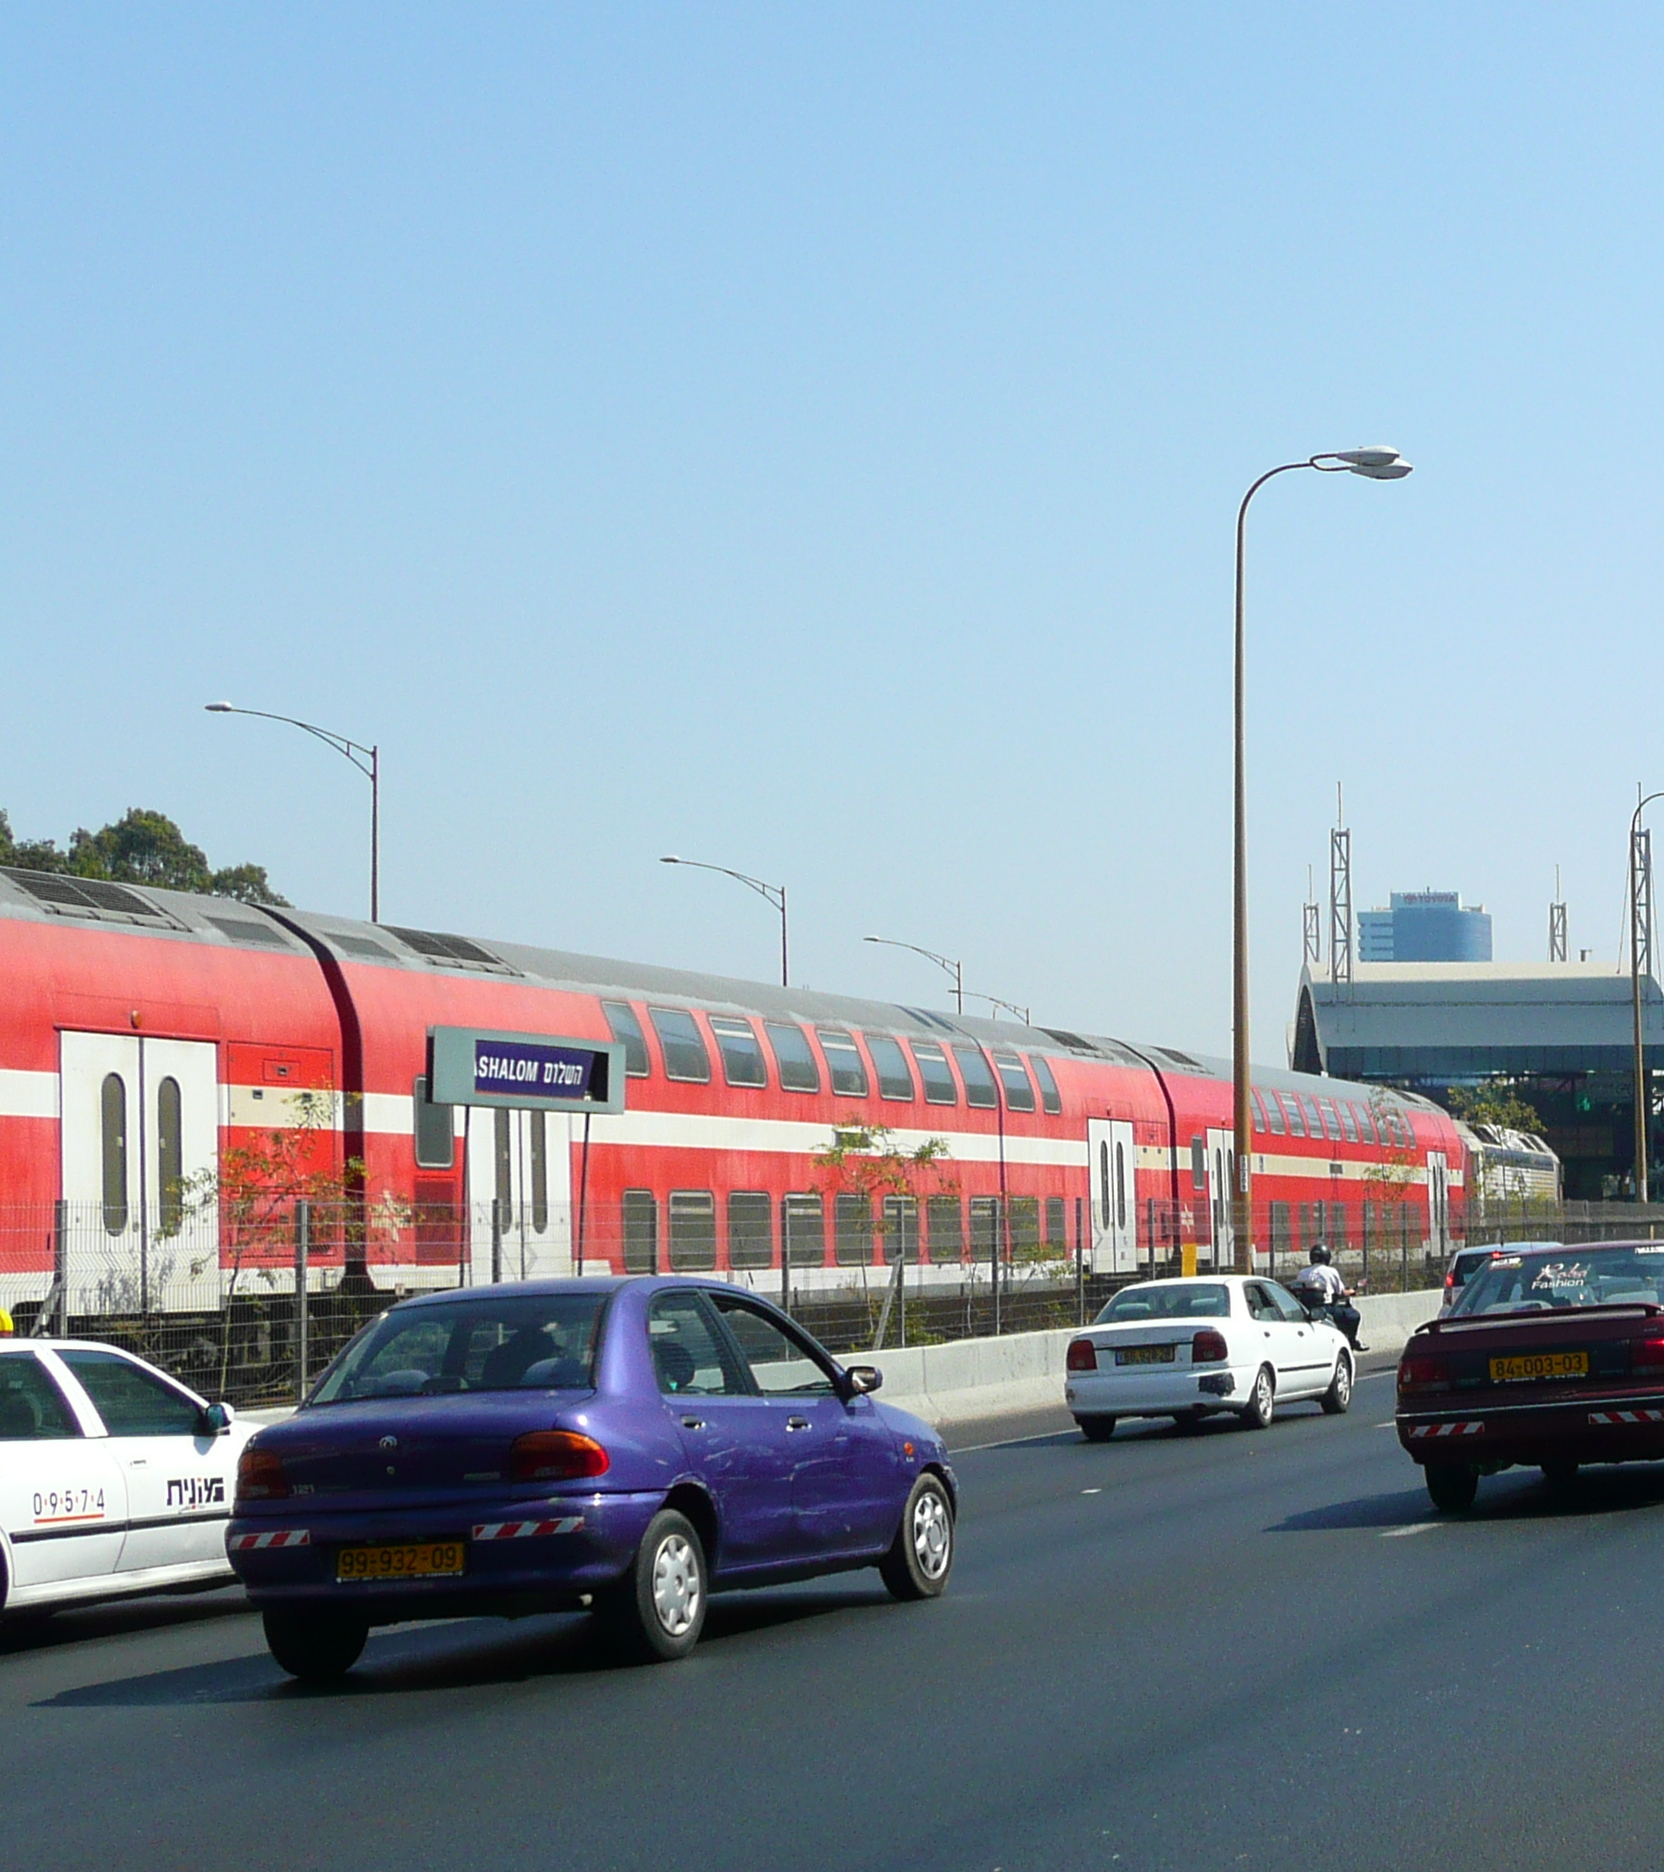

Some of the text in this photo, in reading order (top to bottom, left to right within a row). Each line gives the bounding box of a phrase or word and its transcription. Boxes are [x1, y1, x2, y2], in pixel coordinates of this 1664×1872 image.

[1418, 894, 1456, 903] TOYOTA
[543, 1061, 584, 1085] השלום
[1531, 1278, 1585, 1291] Fashion
[1495, 1354, 1583, 1377] 84-003-03
[341, 1546, 457, 1575] 99-932-09
